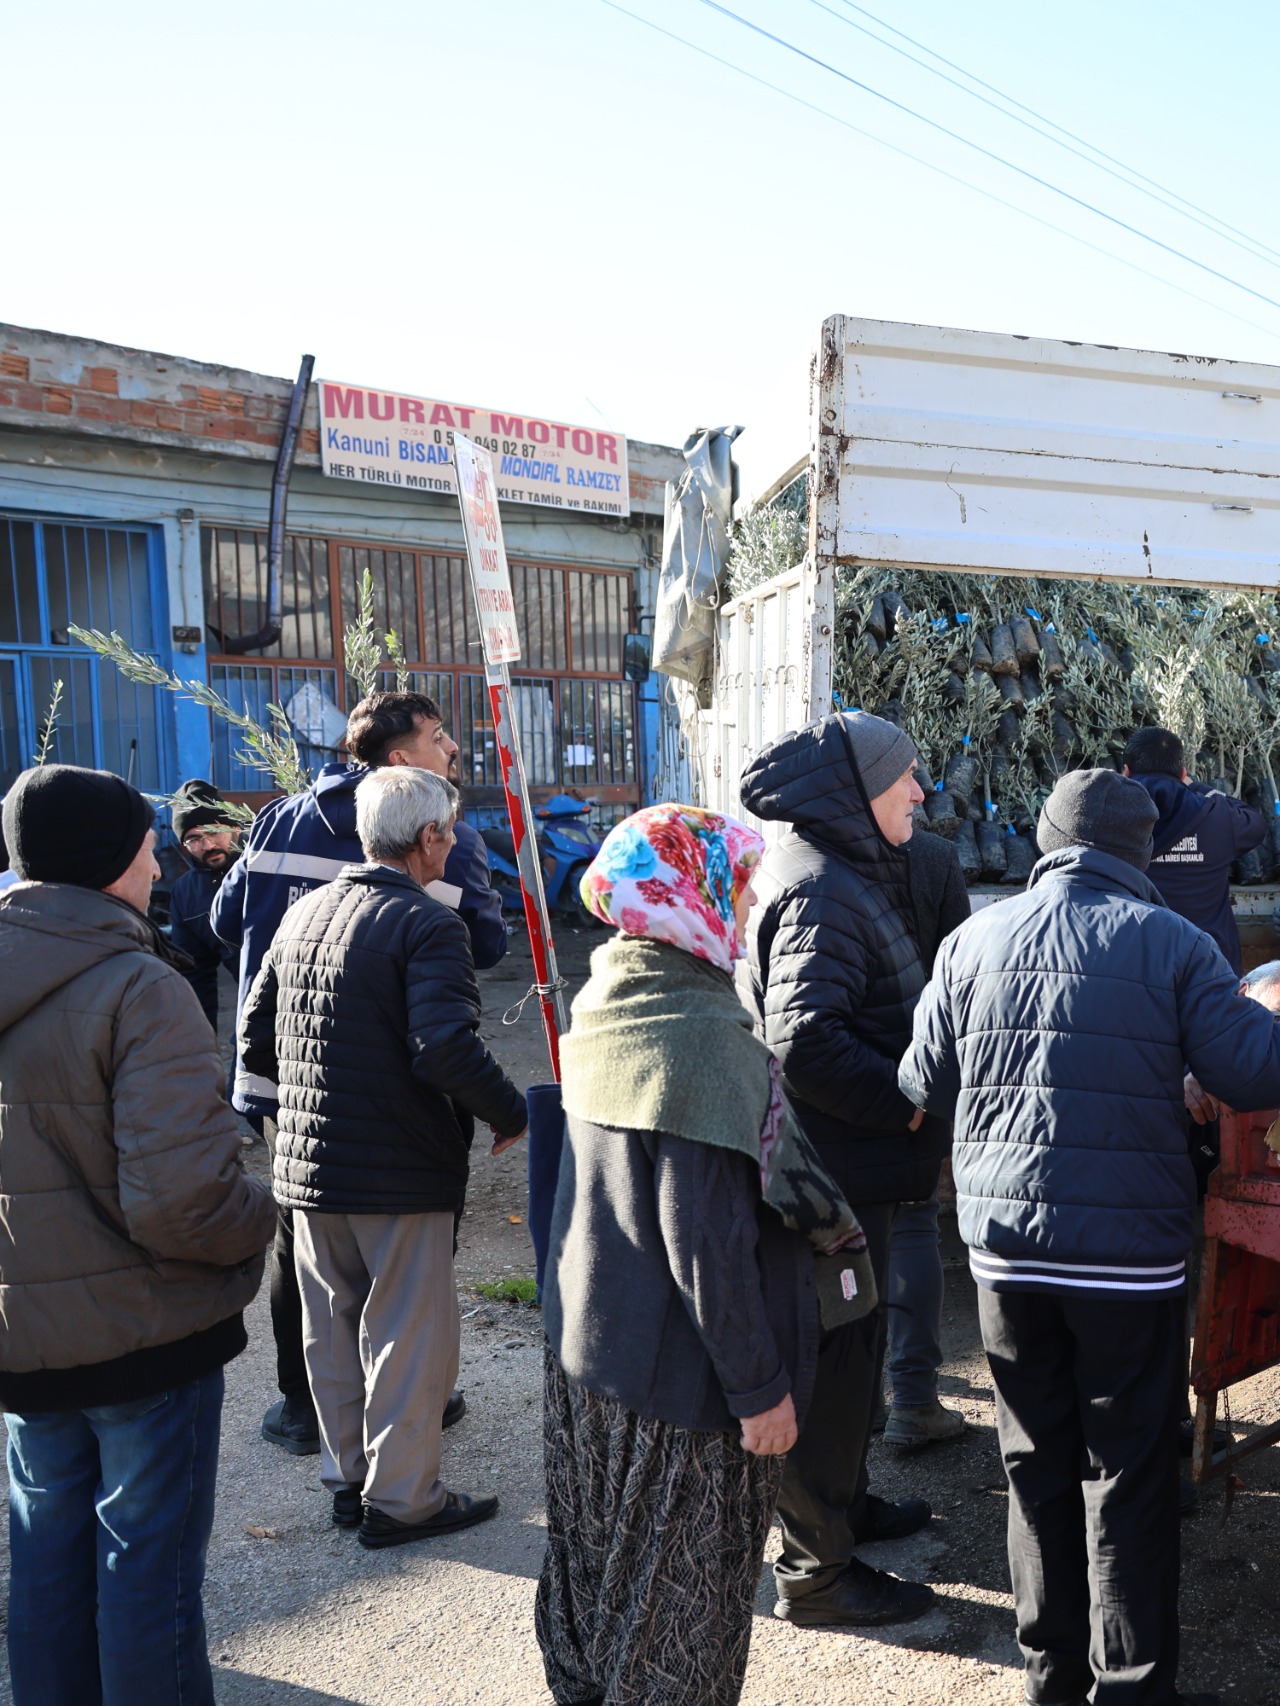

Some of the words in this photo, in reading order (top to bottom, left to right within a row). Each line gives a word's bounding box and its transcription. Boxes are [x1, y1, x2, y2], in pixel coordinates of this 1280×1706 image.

[324, 383, 476, 429] MURAT
[490, 412, 618, 465] MOTOR
[433, 429, 442, 444] 0
[502, 440, 518, 457] 02
[521, 443, 536, 459] 87
[327, 427, 390, 458] Kanuni
[398, 440, 449, 466] BİSAN
[566, 466, 622, 493] RAMZEY
[330, 463, 355, 478] HER
[359, 466, 401, 484] TÜRLÜ
[406, 474, 451, 491] MOTOR
[527, 490, 562, 506] TAMİR
[567, 499, 580, 508] ve
